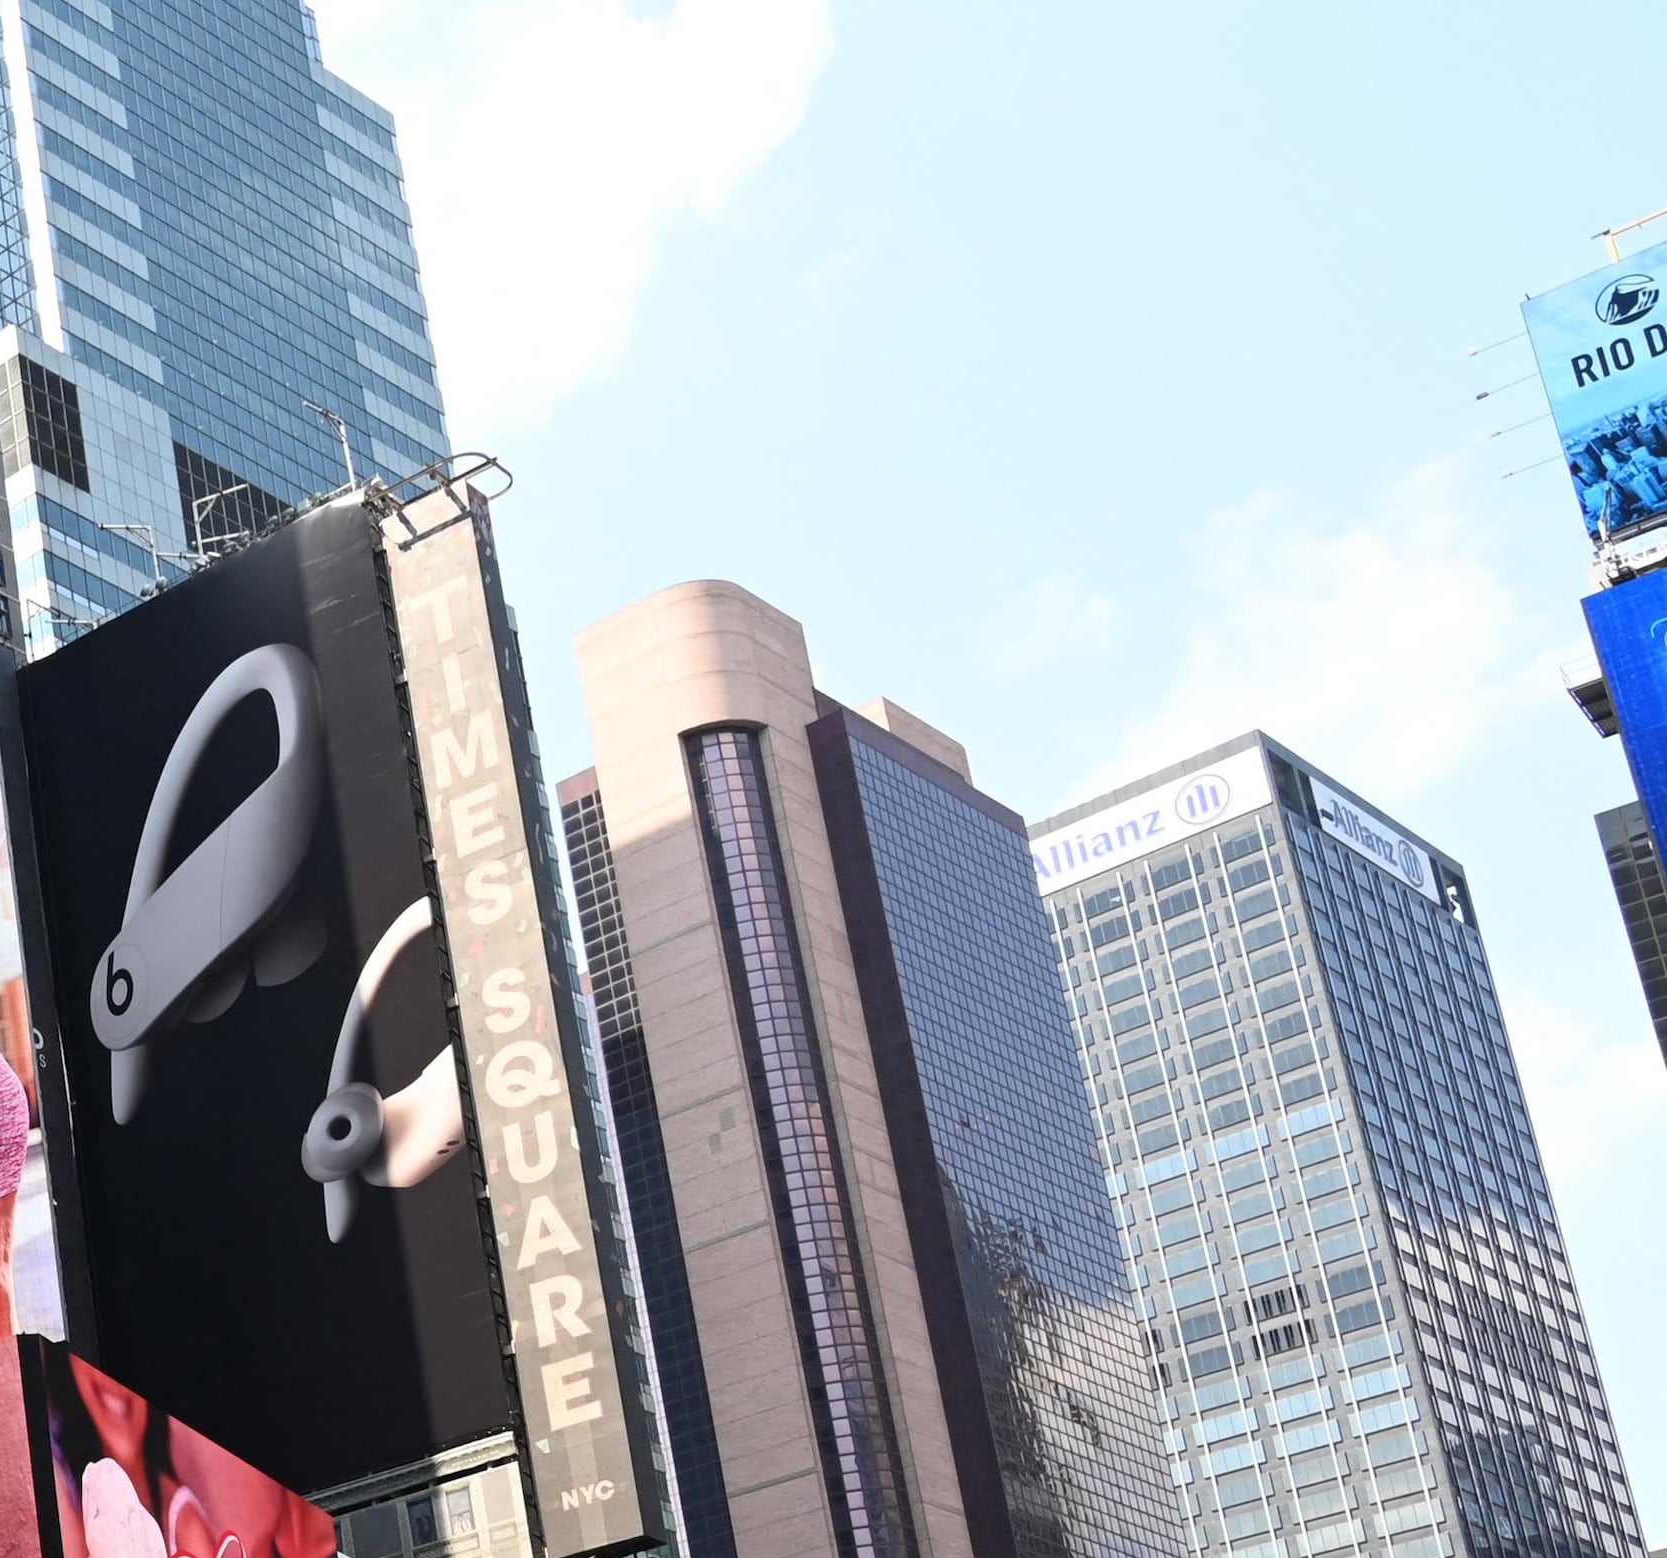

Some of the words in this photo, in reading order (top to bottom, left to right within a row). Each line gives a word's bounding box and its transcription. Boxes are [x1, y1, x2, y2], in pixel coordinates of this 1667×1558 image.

[1571, 337, 1635, 388] RIO
[1330, 801, 1399, 868] Allianz
[405, 588, 515, 927] TIMES
[480, 966, 604, 1432] SQUARE
[560, 1477, 616, 1512] NYC
